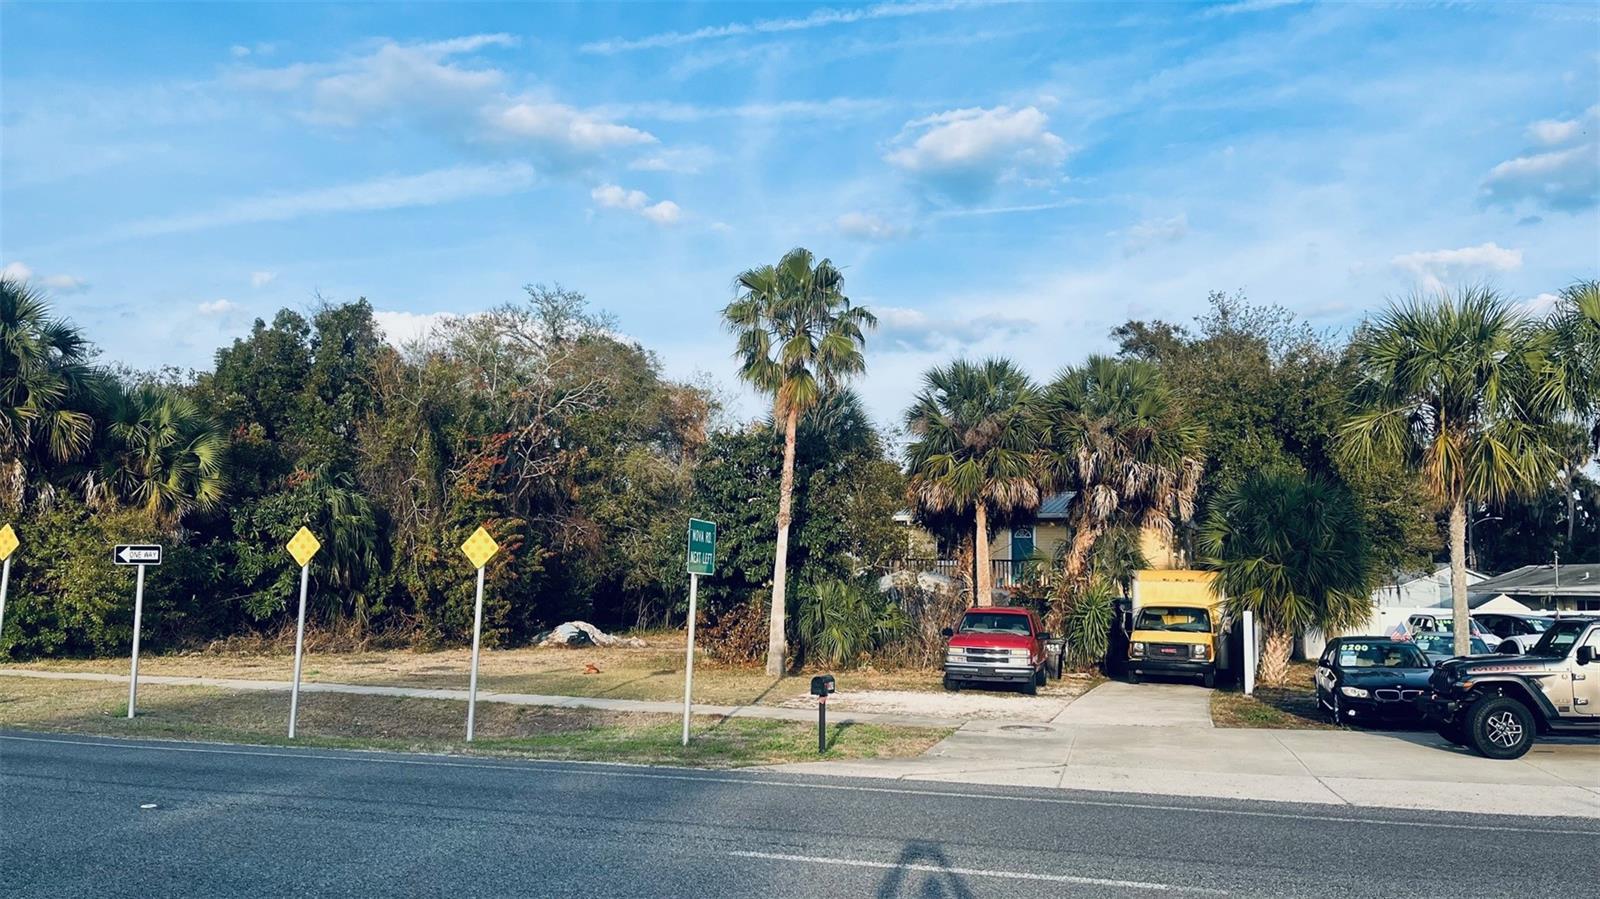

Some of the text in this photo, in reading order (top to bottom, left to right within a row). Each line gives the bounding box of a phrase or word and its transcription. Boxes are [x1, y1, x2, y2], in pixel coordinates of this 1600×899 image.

[692, 530, 704, 543] NOVA
[690, 551, 713, 565] NEXT LEFT
